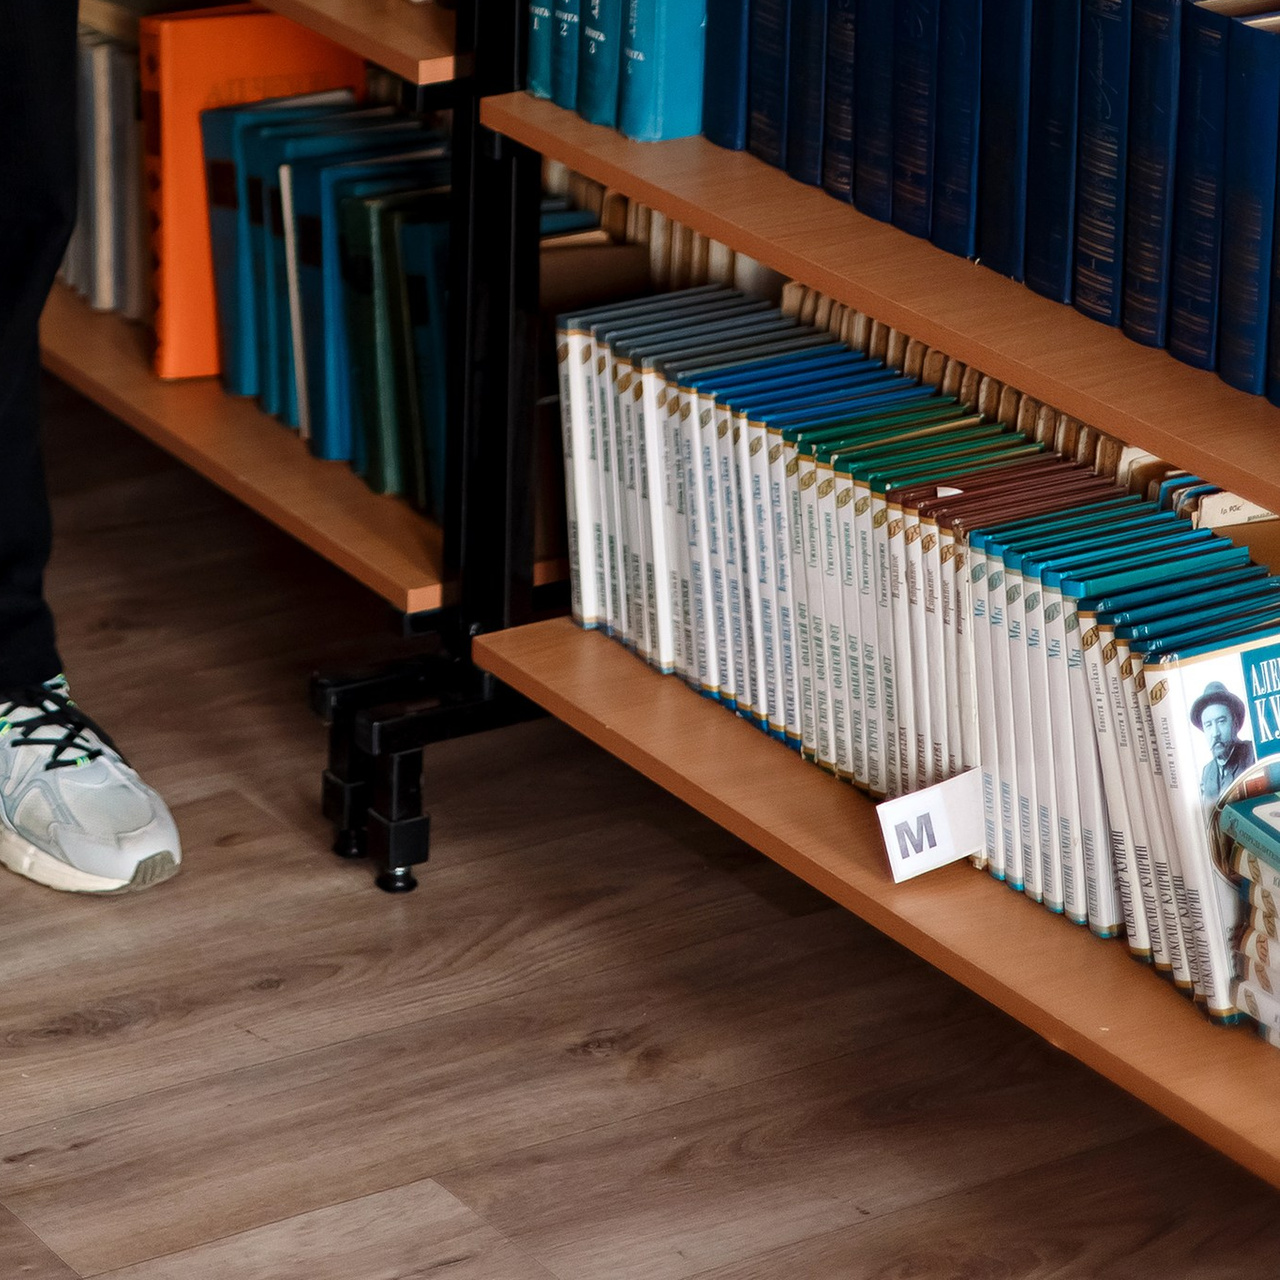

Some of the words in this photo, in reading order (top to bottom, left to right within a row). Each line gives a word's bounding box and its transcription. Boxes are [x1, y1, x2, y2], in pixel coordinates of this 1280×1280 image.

[974, 598, 986, 618] Мы
[991, 606, 1003, 626] Мы
[1008, 620, 1021, 640] Мы
[1027, 628, 1040, 648] Мы
[1047, 639, 1060, 659] Мы
[1067, 648, 1081, 669] Мы
[894, 811, 938, 860] М
[1112, 830, 1128, 874] КУПРИН
[1135, 845, 1153, 888] КУПРИН
[1155, 861, 1173, 905] КУПРИН
[1119, 876, 1137, 941] АЛЕКСАНДР
[1143, 890, 1163, 956] АЛЕКСАНДР
[1162, 908, 1183, 972] АЛЕКСАНДР
